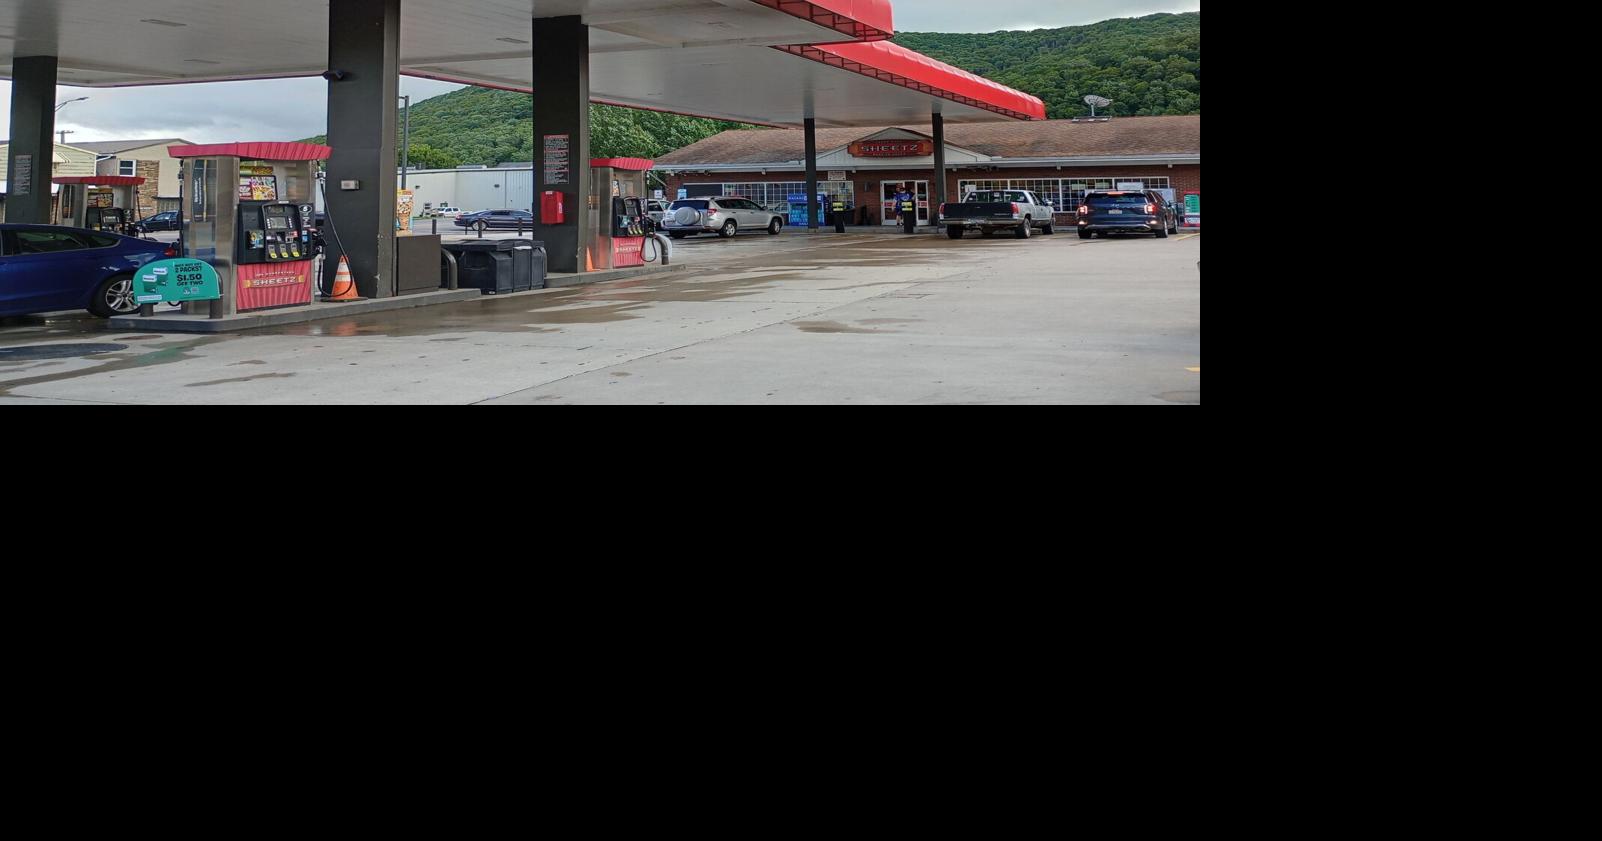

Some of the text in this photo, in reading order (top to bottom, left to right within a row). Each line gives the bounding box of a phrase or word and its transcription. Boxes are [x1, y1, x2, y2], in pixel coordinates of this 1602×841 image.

[861, 144, 917, 152] SHEETZ
[176, 273, 202, 282] $1.50
[254, 276, 296, 286] SHEETZ
